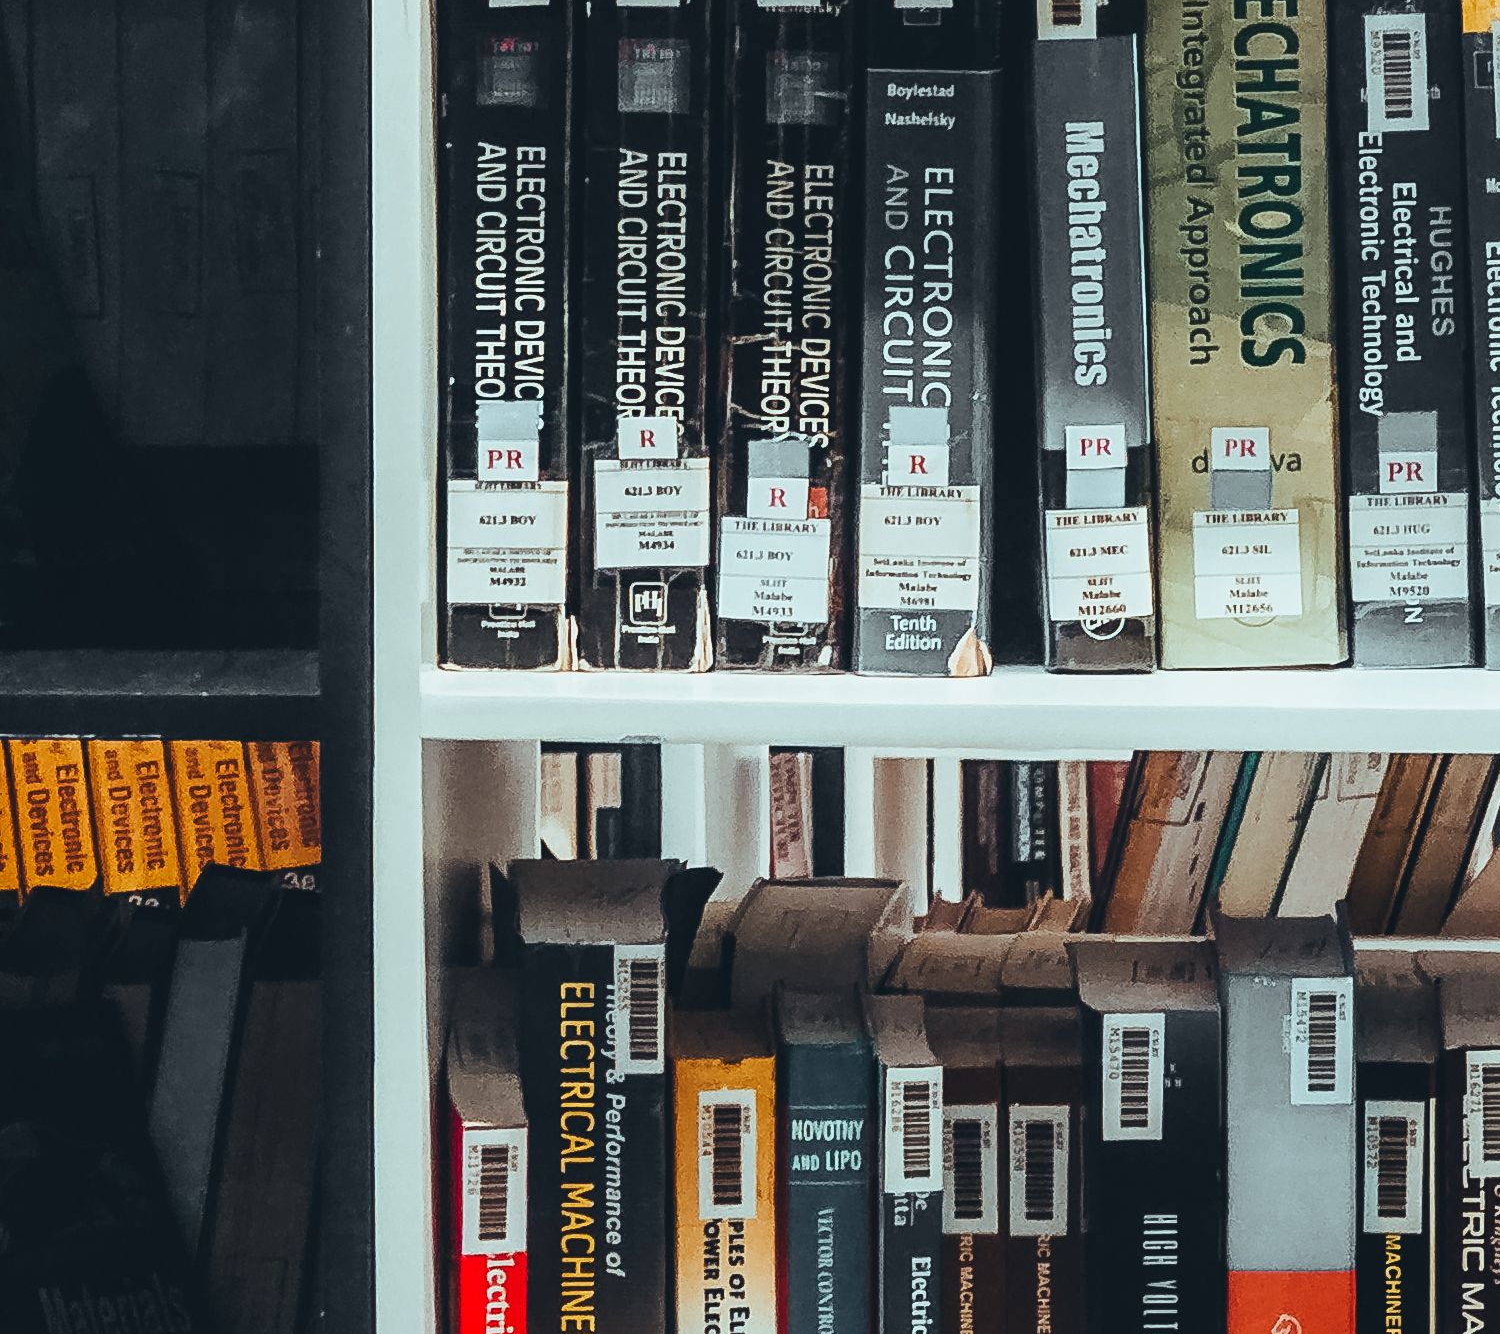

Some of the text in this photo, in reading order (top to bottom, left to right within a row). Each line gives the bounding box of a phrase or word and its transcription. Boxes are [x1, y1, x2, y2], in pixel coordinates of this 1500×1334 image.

[885, 111, 955, 129] Nashelsky
[887, 82, 954, 100] Boylestad
[1178, 1, 1210, 183] Integrated
[476, 142, 507, 317] AND CIRCUIT
[515, 146, 546, 314] ELECTRONIC
[883, 164, 913, 402] AND CIRCUIT
[920, 167, 954, 408] ELECTRONIC
[1065, 121, 1112, 387] Mechatronics
[1178, 193, 1217, 367] Approach
[1358, 131, 1386, 417] Electronic Technology
[1391, 182, 1420, 362] Electrical and
[1430, 206, 1455, 337] HUGHES
[487, 449, 522, 471] PR
[885, 633, 942, 652] Edition
[889, 614, 936, 632] Tenth
[27, 788, 54, 876] Devices
[57, 764, 87, 874] Electronic
[560, 981, 596, 1174] ELECTRICAL
[792, 1119, 865, 1143] NOVOTNY
[605, 1094, 627, 1278] Performance of
[792, 1150, 863, 1173] AND LIPO
[1143, 1214, 1179, 1267] HIGH
